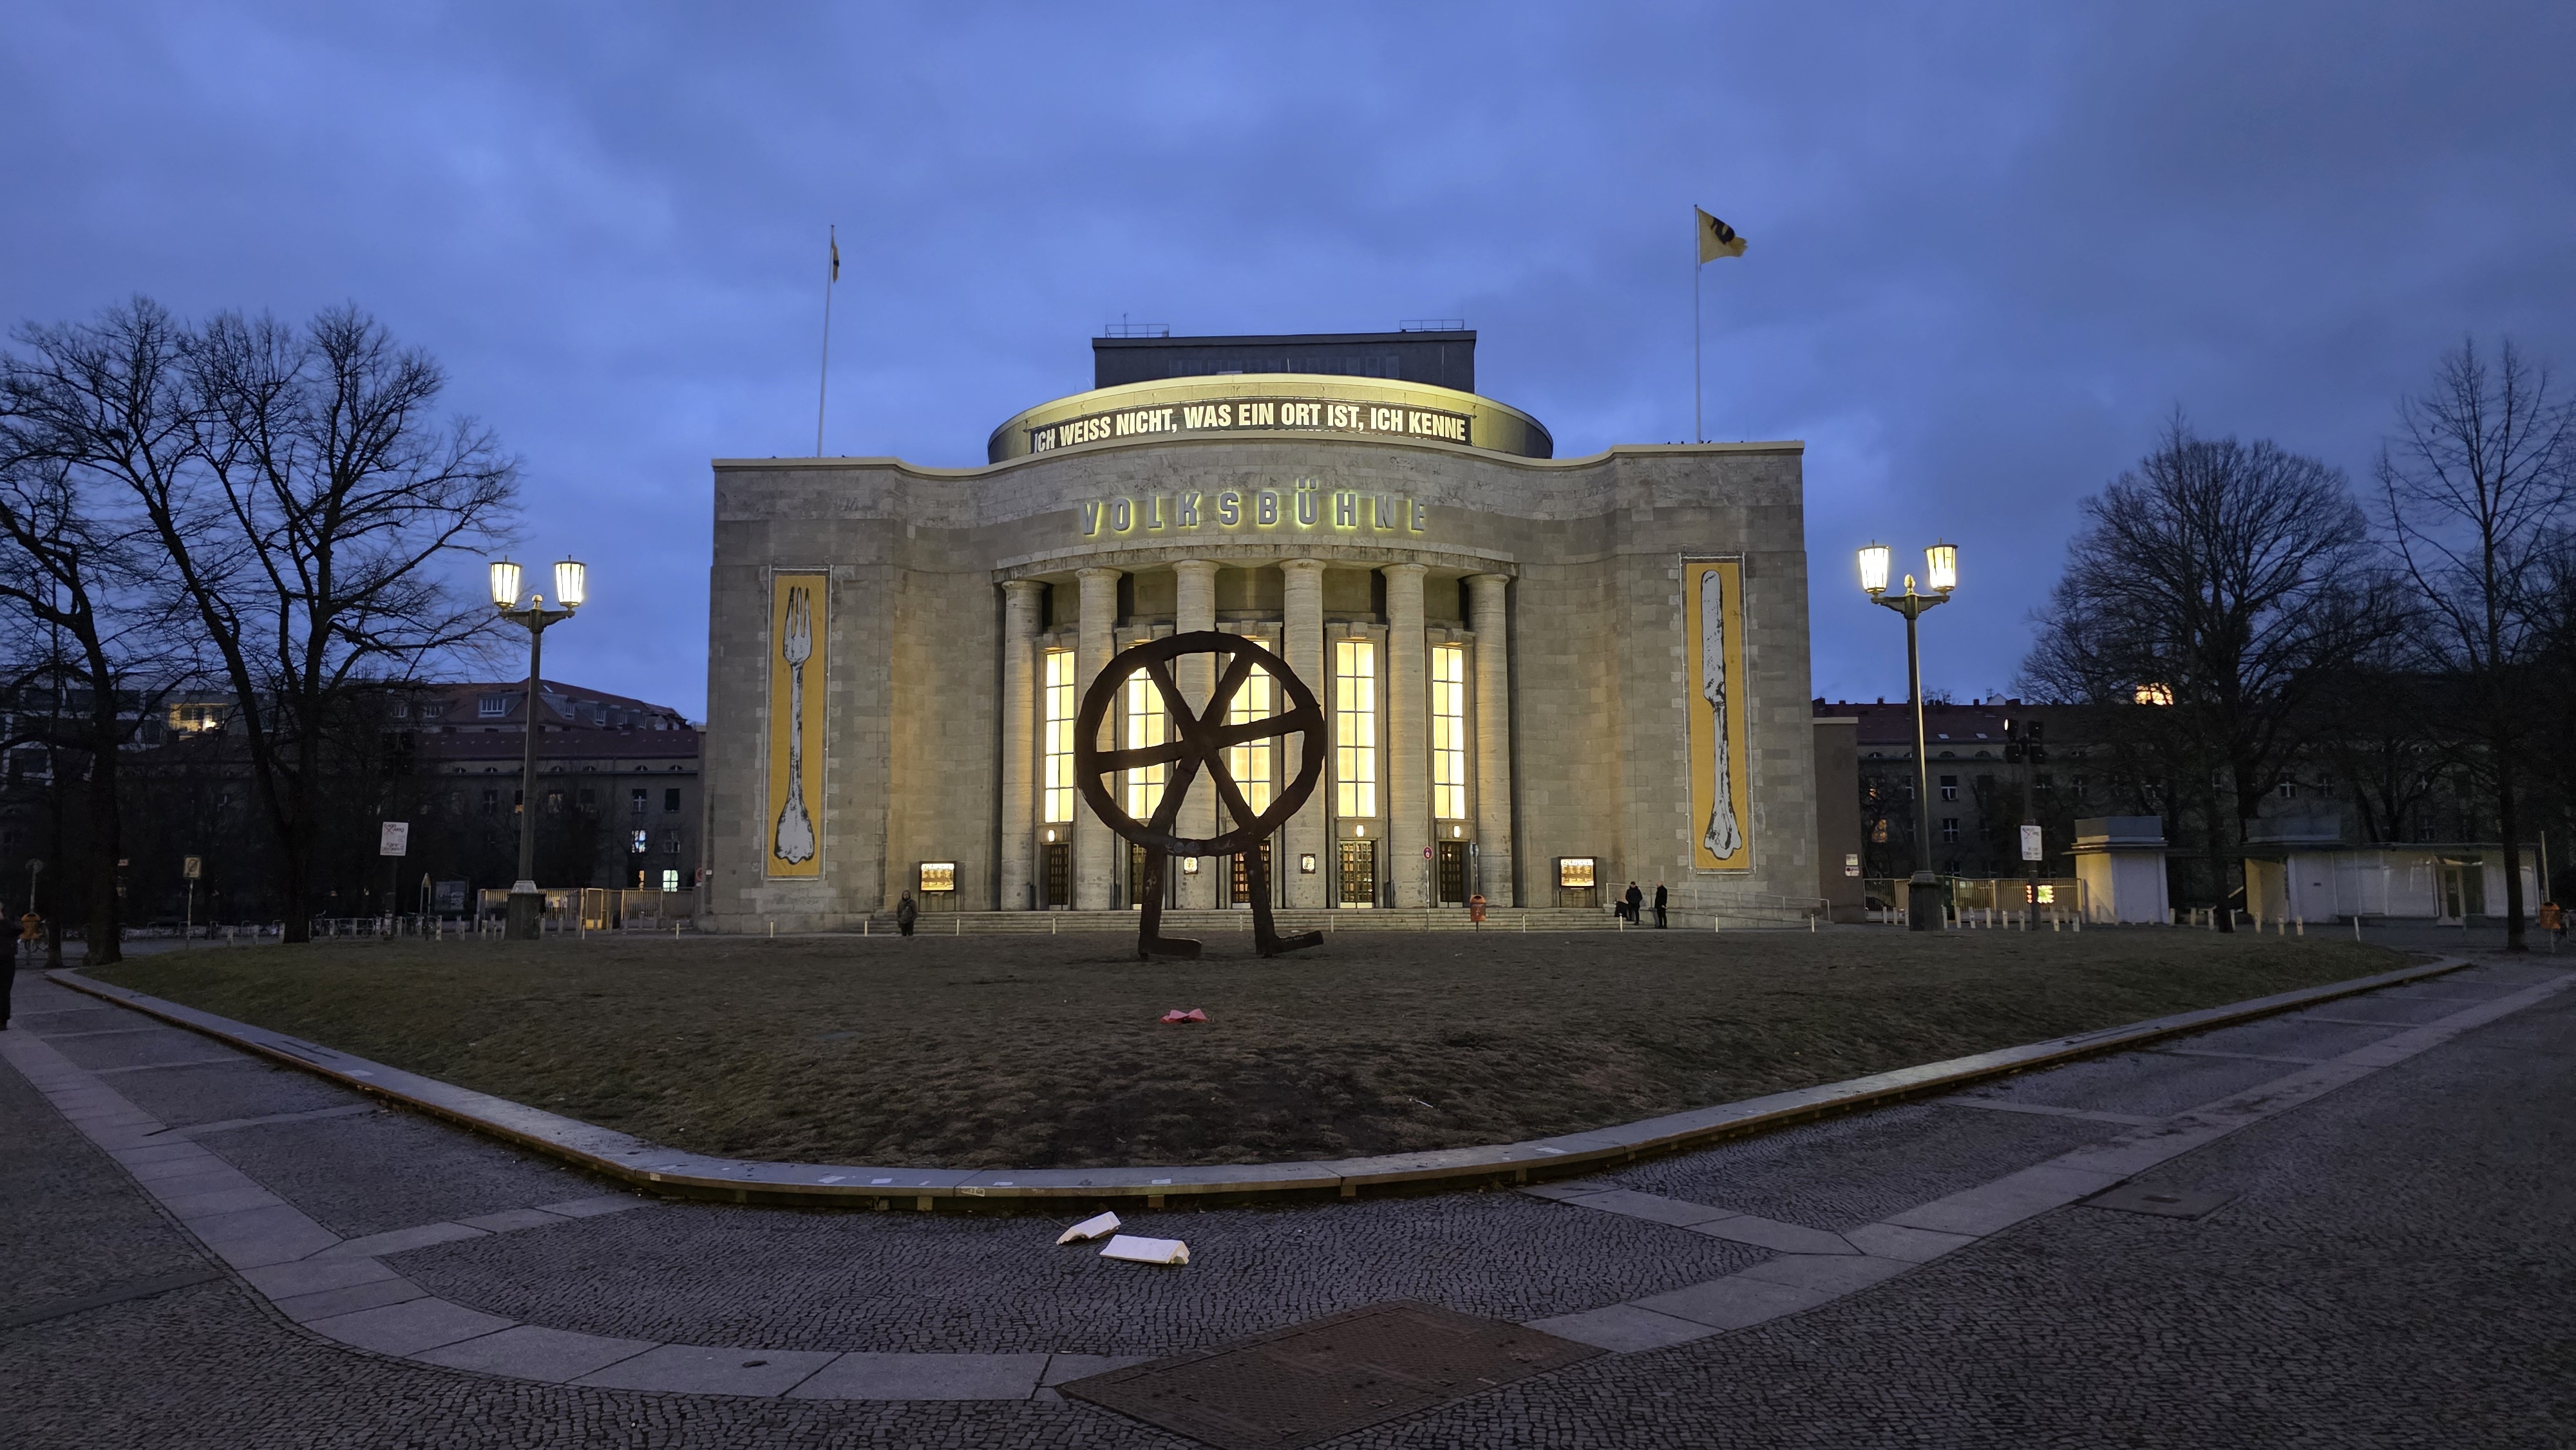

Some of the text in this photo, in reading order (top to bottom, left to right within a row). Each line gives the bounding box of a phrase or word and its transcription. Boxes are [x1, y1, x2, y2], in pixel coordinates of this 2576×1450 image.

[1034, 402, 1466, 453] ICH WEISS NICHT, WAS EIN ORT IST, ICH KENNE
[1078, 478, 1425, 536] VOLKSBÜHNE
